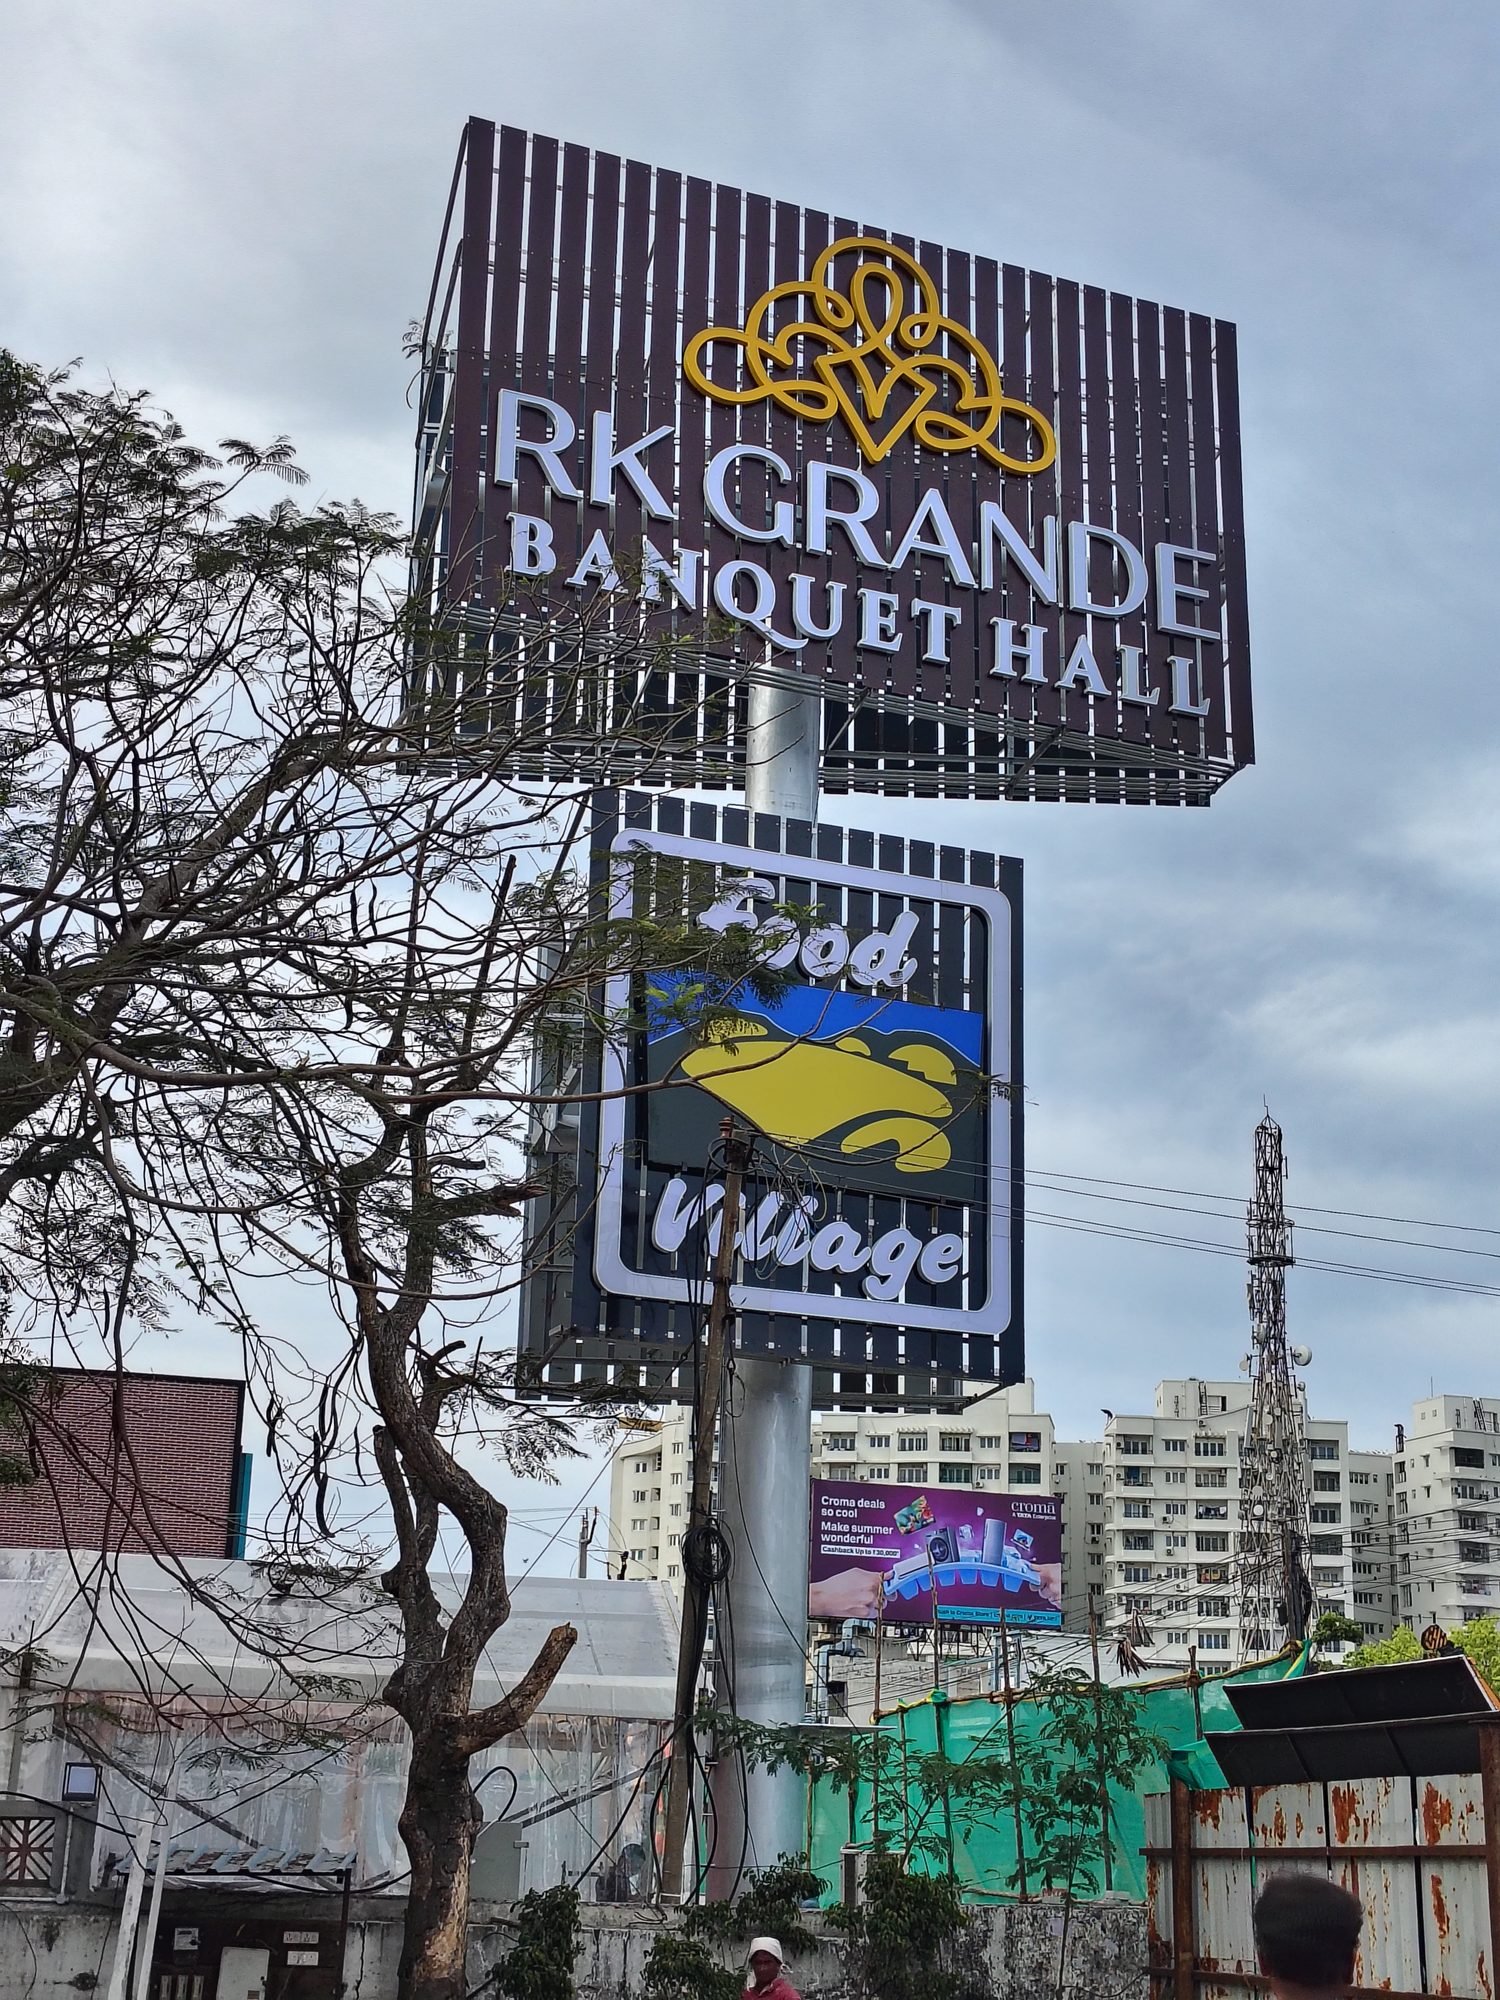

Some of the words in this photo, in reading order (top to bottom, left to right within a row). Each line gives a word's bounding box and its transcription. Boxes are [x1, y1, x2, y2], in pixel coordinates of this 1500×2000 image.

[494, 389, 675, 521] RK
[703, 444, 1221, 642] GRANDE
[505, 512, 961, 664] BANQUET
[988, 616, 1211, 717] HALL
[695, 877, 919, 988] Food
[652, 1178, 964, 1301] Village
[821, 1495, 856, 1507] Croma
[857, 1498, 886, 1509] deals
[821, 1508, 834, 1517] so
[835, 1508, 858, 1518] cool
[821, 1521, 850, 1532] Make
[851, 1524, 894, 1535] summer
[820, 1533, 874, 1545] wonderful
[822, 1546, 854, 1555] Cashback
